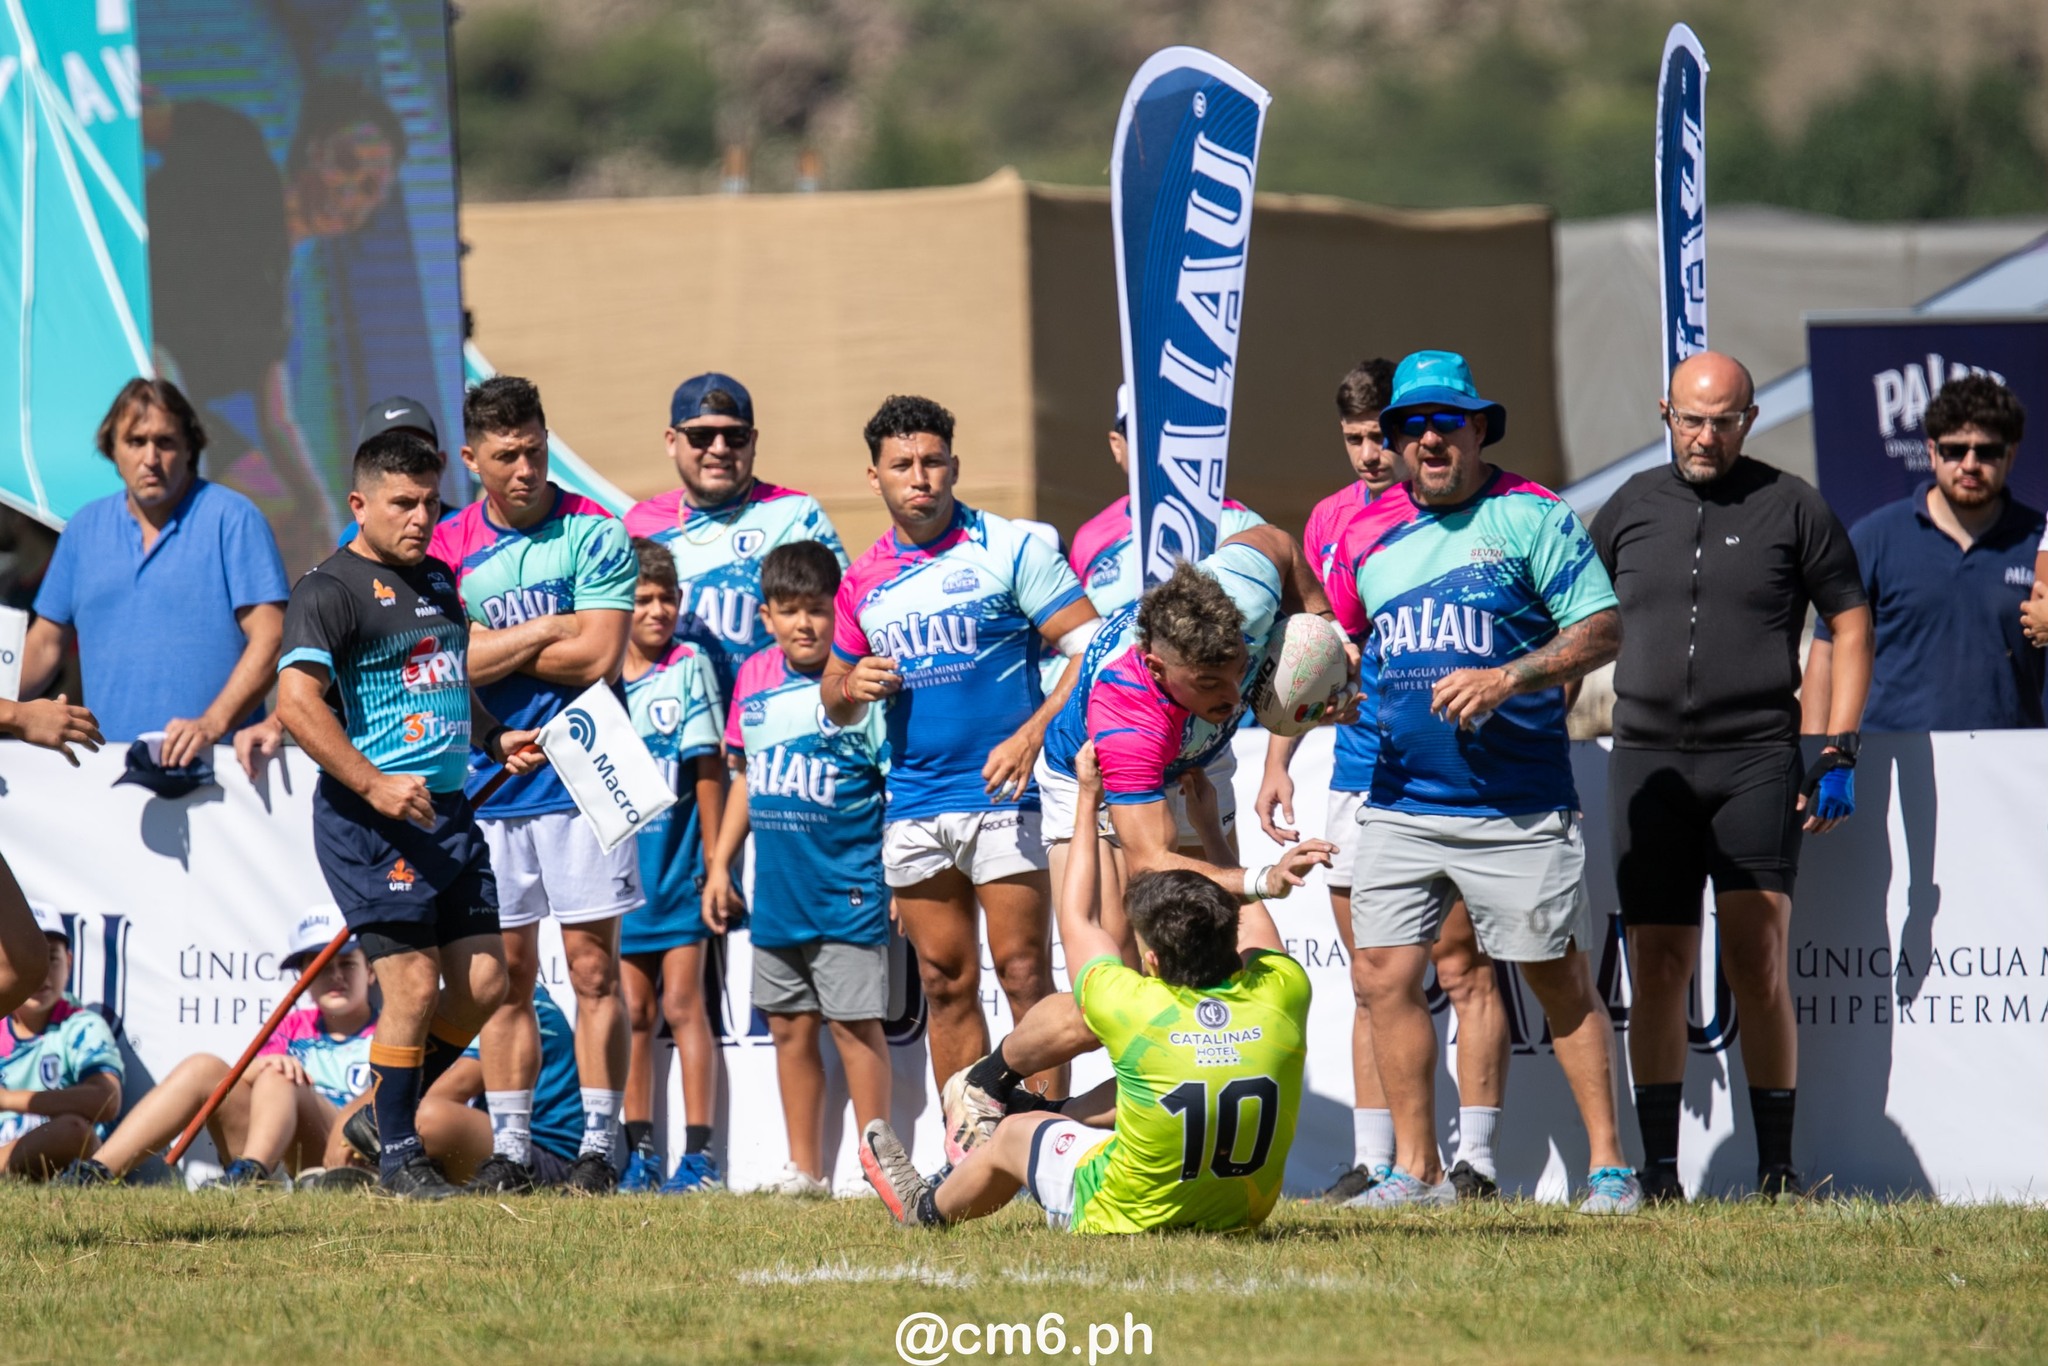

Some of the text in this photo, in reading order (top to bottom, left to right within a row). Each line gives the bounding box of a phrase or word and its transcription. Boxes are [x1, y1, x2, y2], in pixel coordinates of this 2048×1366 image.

[1146, 131, 1255, 583] PALAU
[1873, 353, 2006, 438] PAL
[2004, 565, 2034, 586] PALA
[481, 586, 558, 631] PAAU
[678, 580, 759, 645] LAU
[871, 611, 979, 663] PALAU
[1374, 597, 1495, 662] PALAU
[1407, 667, 1437, 678] AGUA
[423, 715, 470, 739] Tiem
[593, 753, 640, 826] Macro
[979, 816, 1024, 832] PROCER
[179, 944, 301, 982] ÚNICA
[1796, 940, 1915, 979] ÚNICA
[1925, 946, 2029, 977] AGUA
[1796, 994, 2048, 1025] HIPERTERM
[1170, 1028, 1262, 1045] CATALINAS
[1197, 1047, 1237, 1057] HOTEL
[1158, 1075, 1279, 1182] 10
